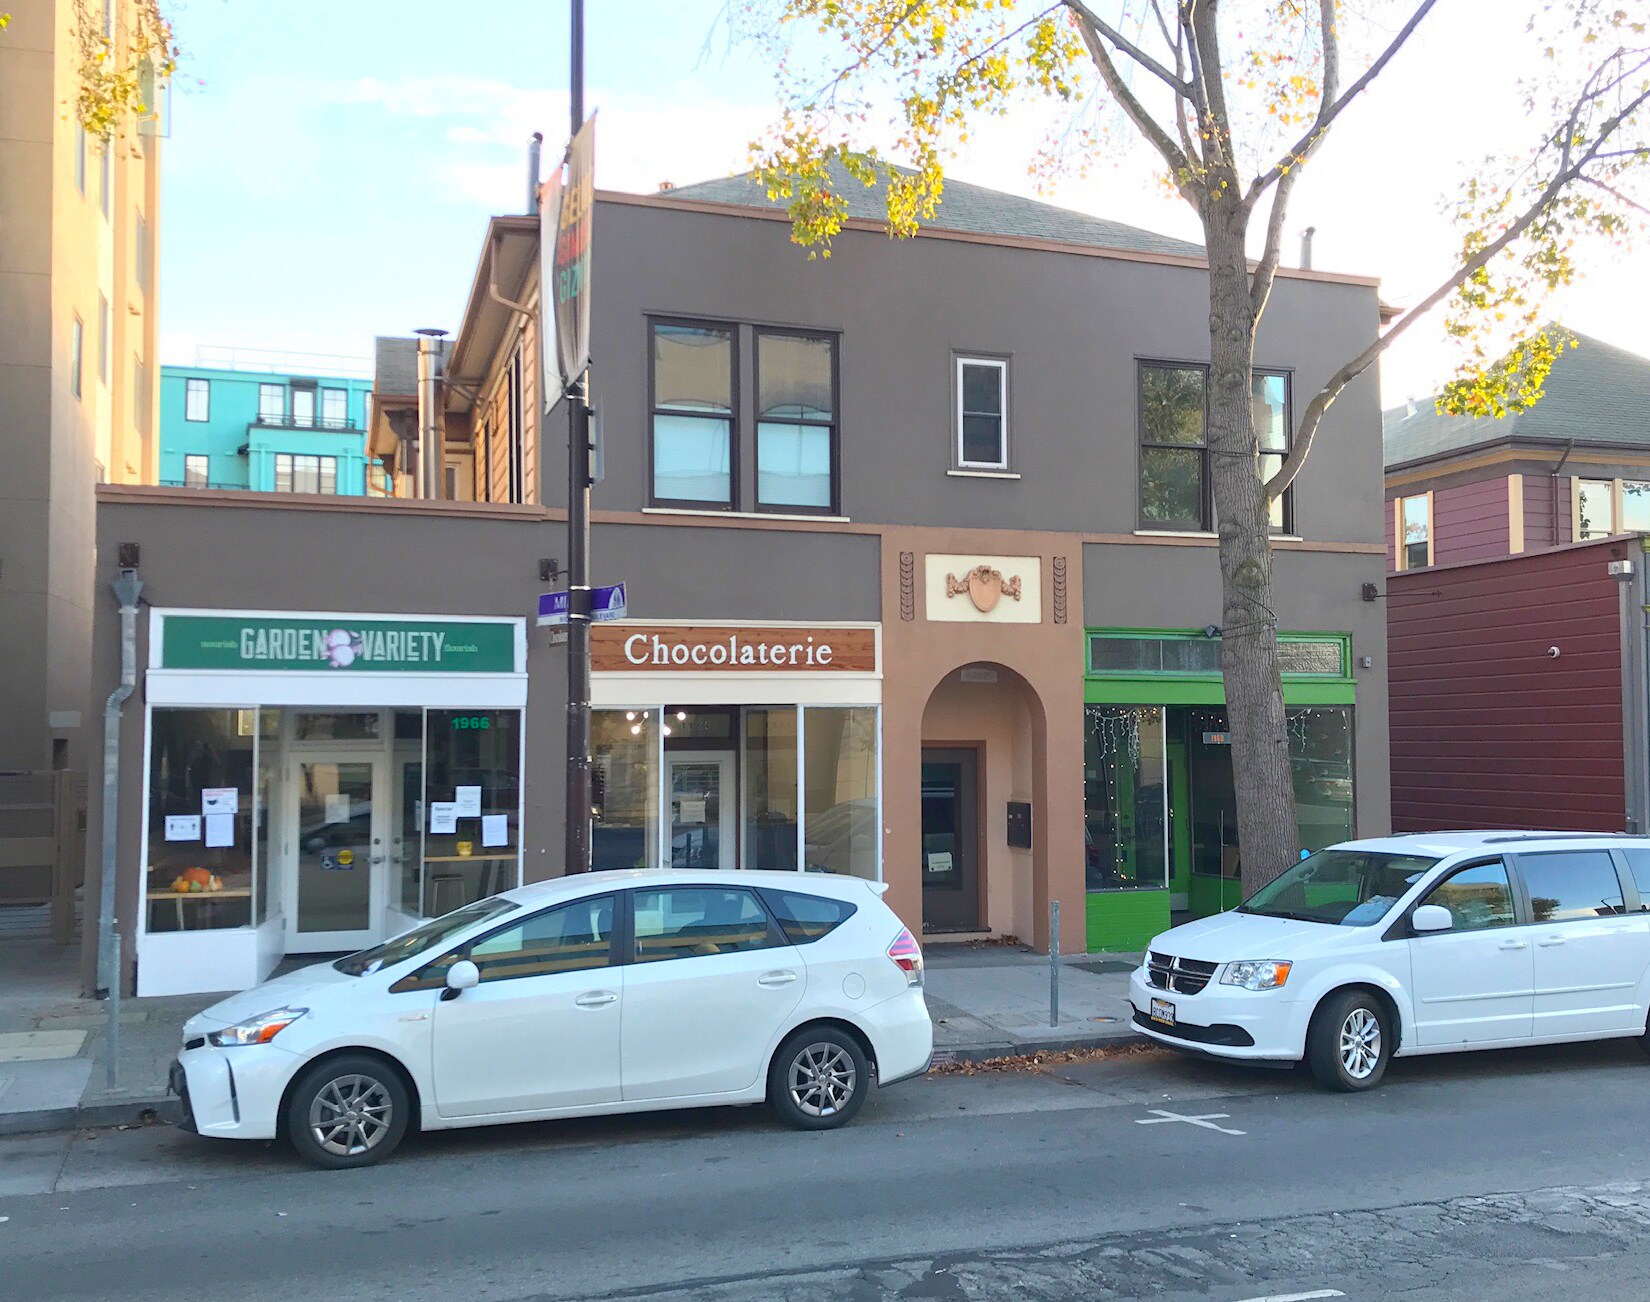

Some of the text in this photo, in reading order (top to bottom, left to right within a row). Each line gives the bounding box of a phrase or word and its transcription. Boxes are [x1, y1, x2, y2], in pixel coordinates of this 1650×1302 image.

[240, 628, 329, 660] GARDEN
[359, 630, 445, 661] VARIETY
[624, 633, 833, 666] Chocolaterie
[451, 717, 490, 730] 1966
